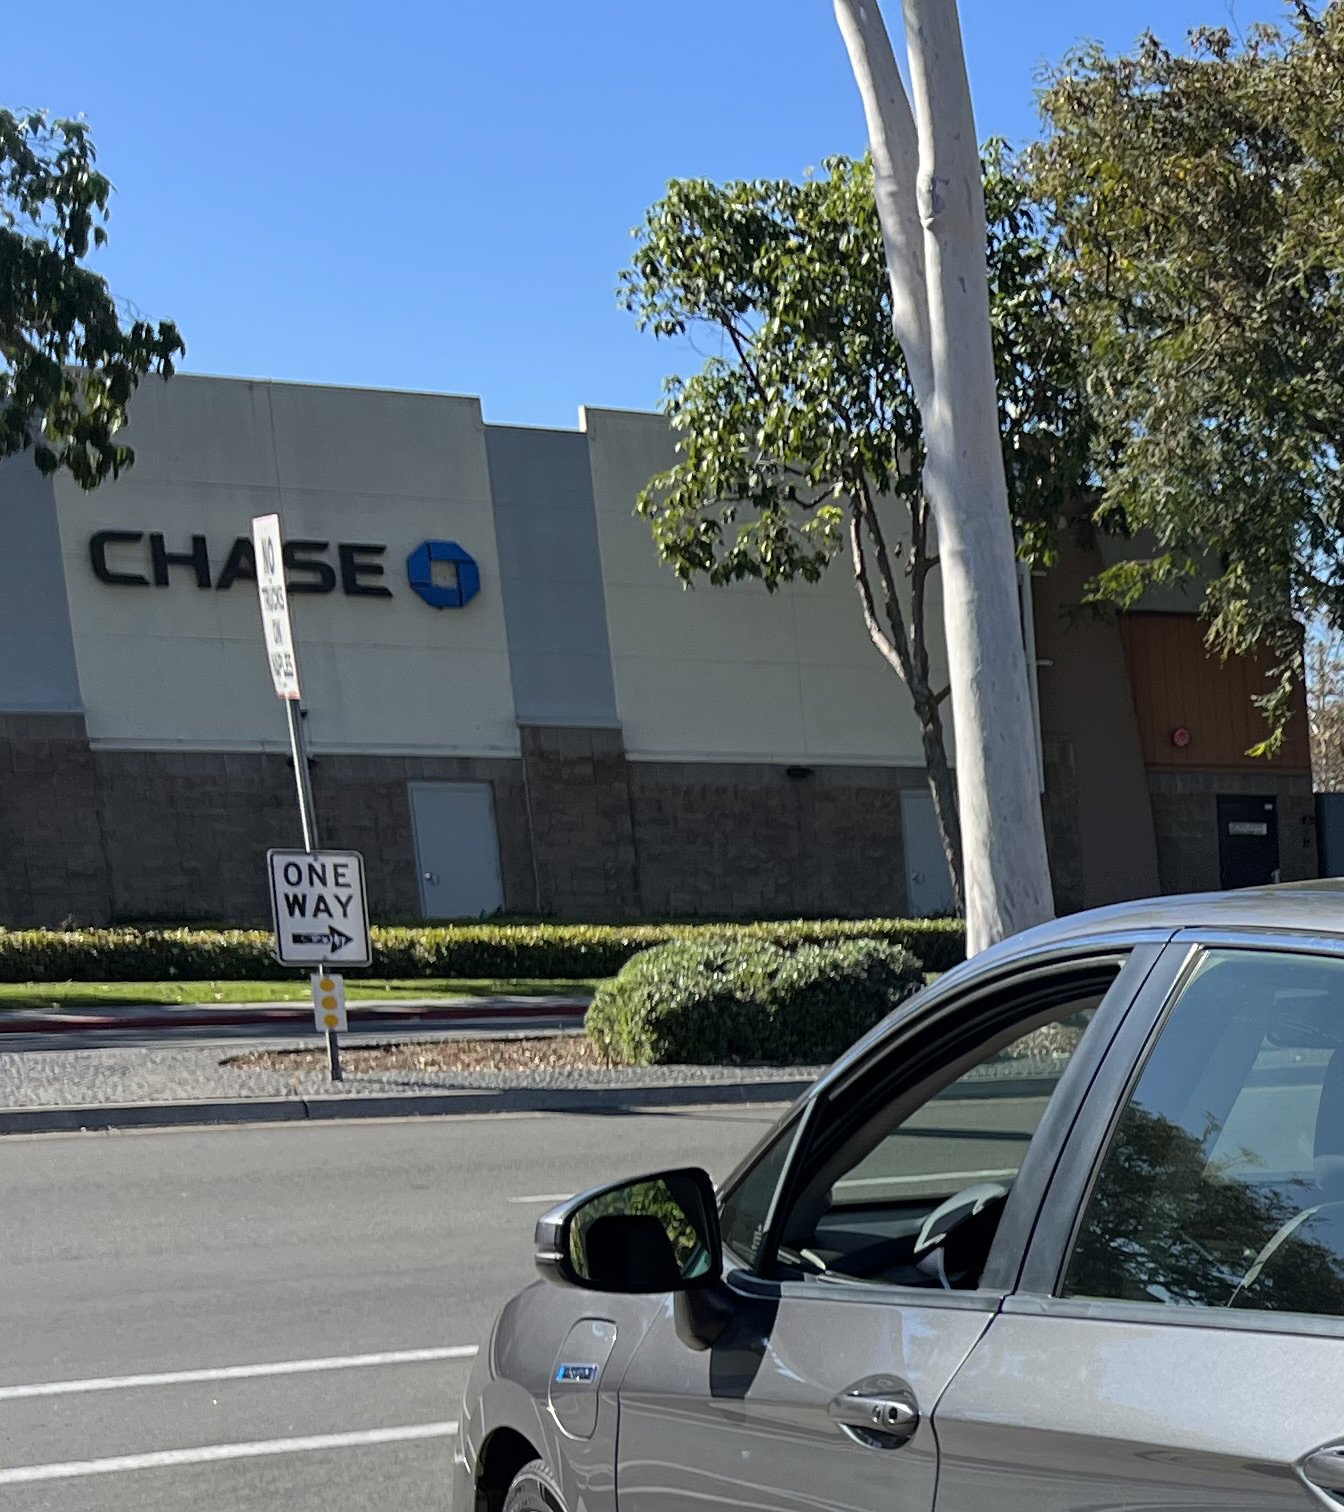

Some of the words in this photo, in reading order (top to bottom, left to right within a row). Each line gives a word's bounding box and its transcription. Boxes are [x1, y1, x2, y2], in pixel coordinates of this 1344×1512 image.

[88, 529, 393, 598] CHASE
[284, 862, 352, 888] ONE
[284, 893, 353, 918] WAY
